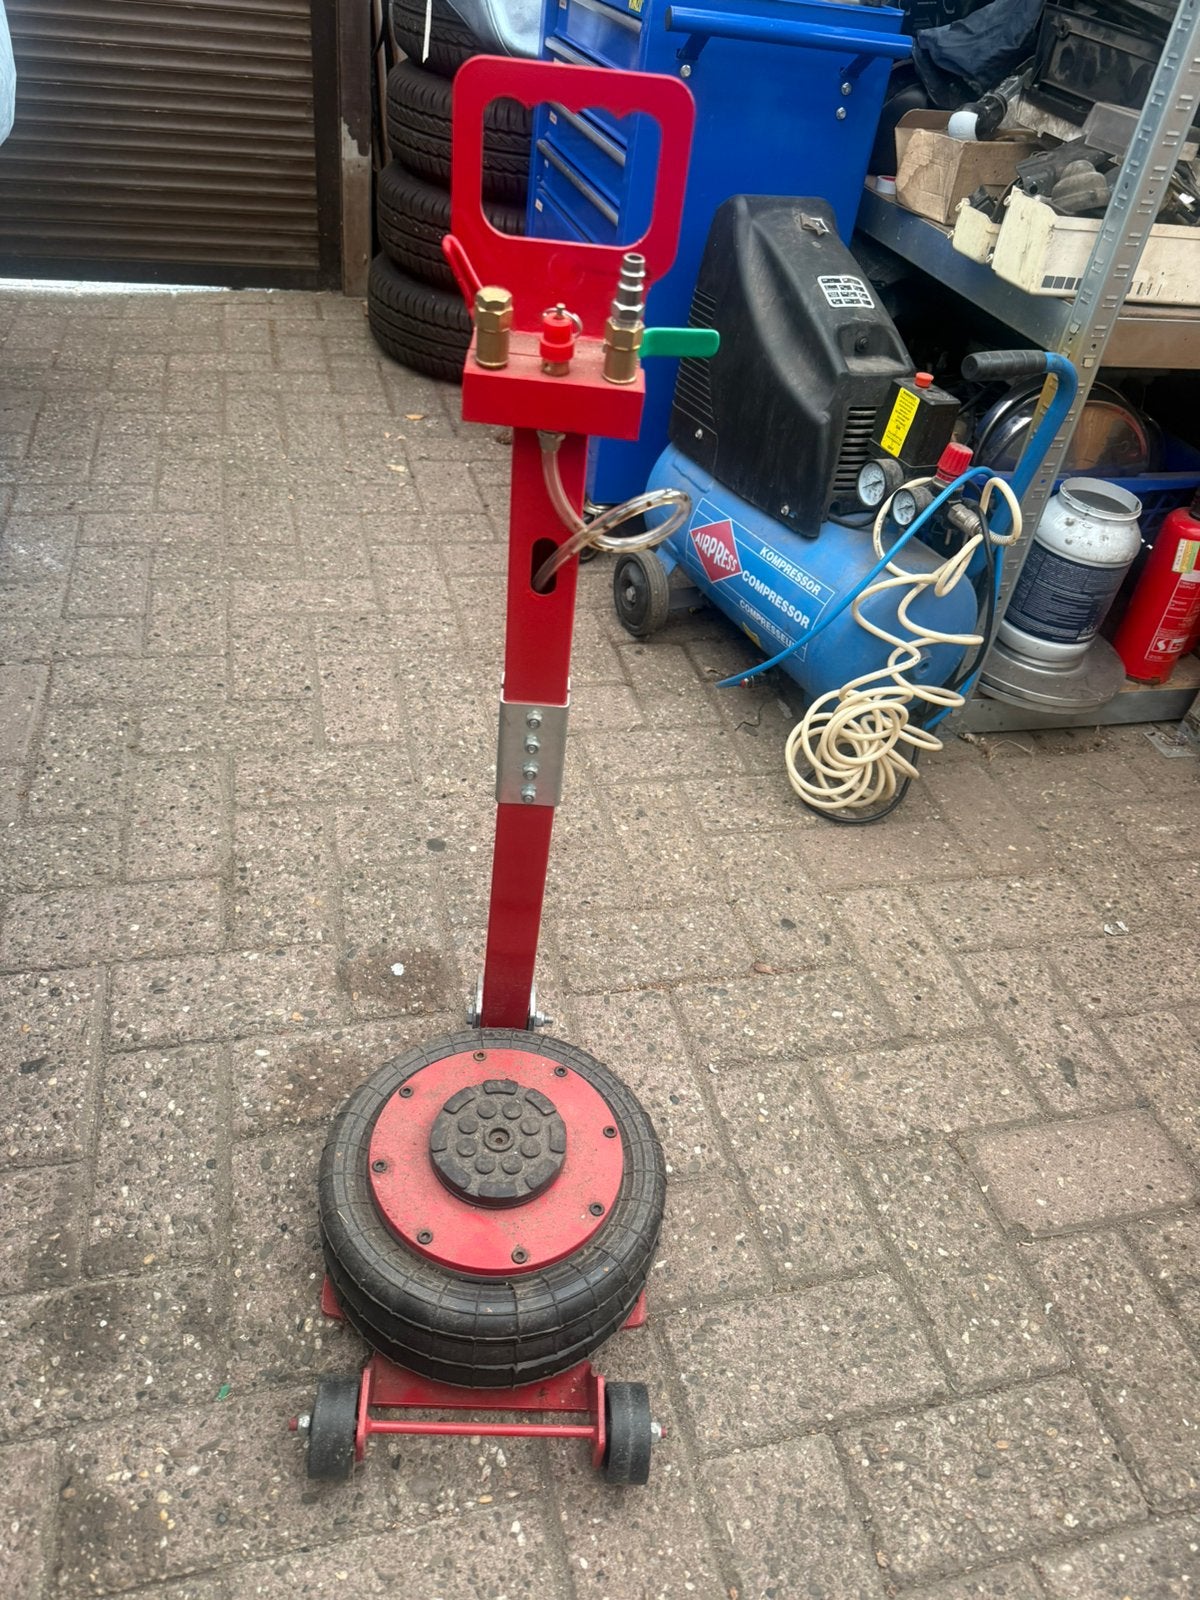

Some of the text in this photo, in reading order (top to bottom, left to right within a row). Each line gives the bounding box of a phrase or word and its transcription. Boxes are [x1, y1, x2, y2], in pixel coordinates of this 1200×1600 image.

[695, 532, 738, 572] AIRPRESS
[760, 546, 821, 596] KOMPRESSOR
[742, 570, 810, 629] COMPRESSOR
